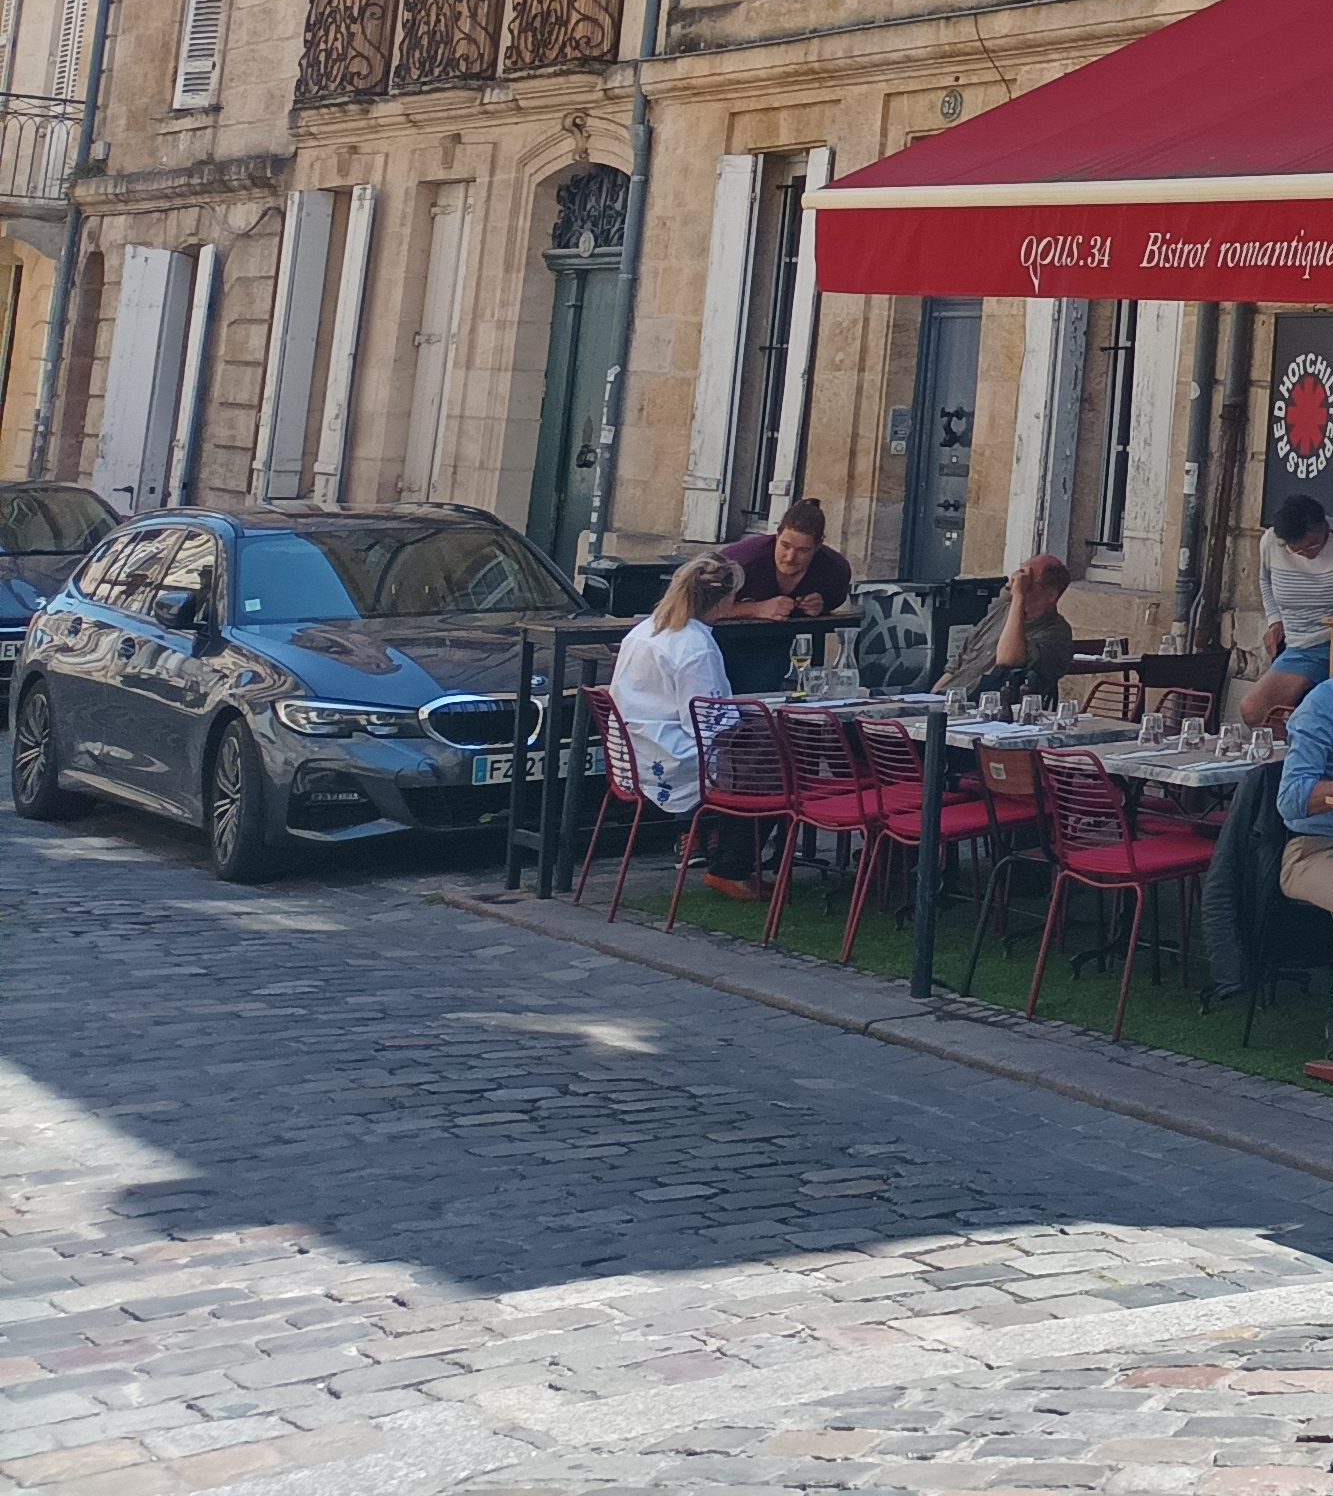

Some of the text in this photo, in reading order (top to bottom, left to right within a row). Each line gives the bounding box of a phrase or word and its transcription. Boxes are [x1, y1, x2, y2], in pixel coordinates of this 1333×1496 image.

[1139, 232, 1212, 269] Bistrot
[1279, 353, 1306, 398] HOT
[1273, 400, 1291, 458] RED
